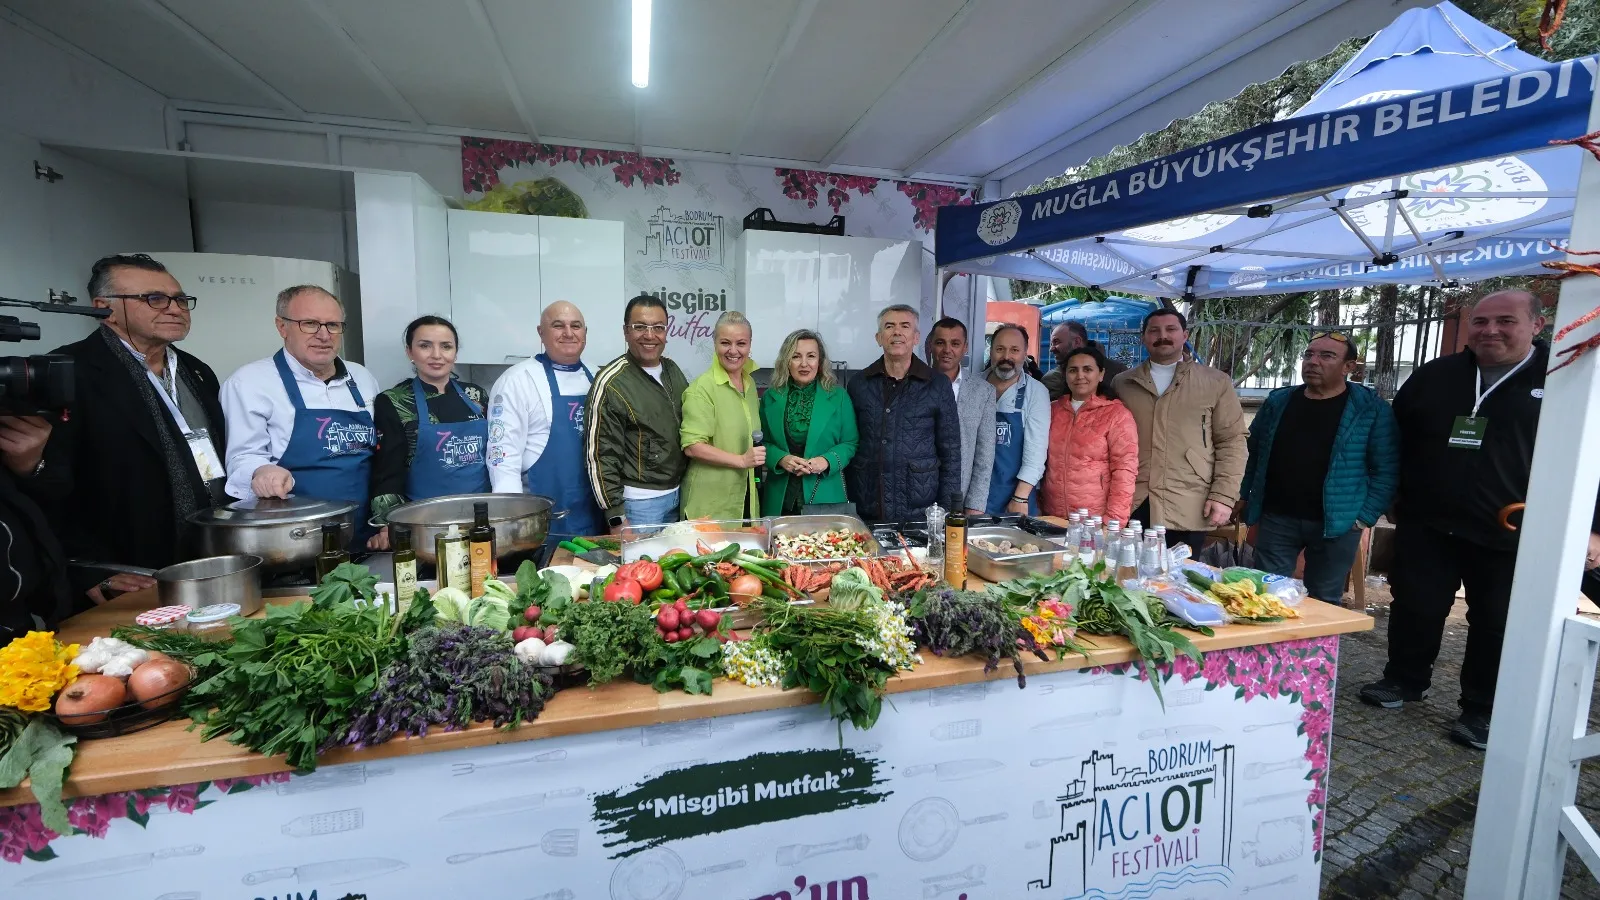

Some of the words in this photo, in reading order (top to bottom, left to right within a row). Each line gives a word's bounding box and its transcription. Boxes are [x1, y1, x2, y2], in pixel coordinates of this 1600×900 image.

[1031, 179, 1120, 220] MUĞLA
[1129, 113, 1360, 196] BÜYÜKŞEHİR
[685, 210, 713, 223] BODRUM
[665, 225, 689, 246] ACI
[692, 227, 714, 247] OT
[198, 276, 256, 285] VESTEL
[467, 443, 479, 454] OT
[1148, 740, 1211, 774] BODRUM
[1098, 791, 1151, 851] ACI
[1160, 778, 1214, 832] OT
[1112, 829, 1200, 878] FESTİVALİ
